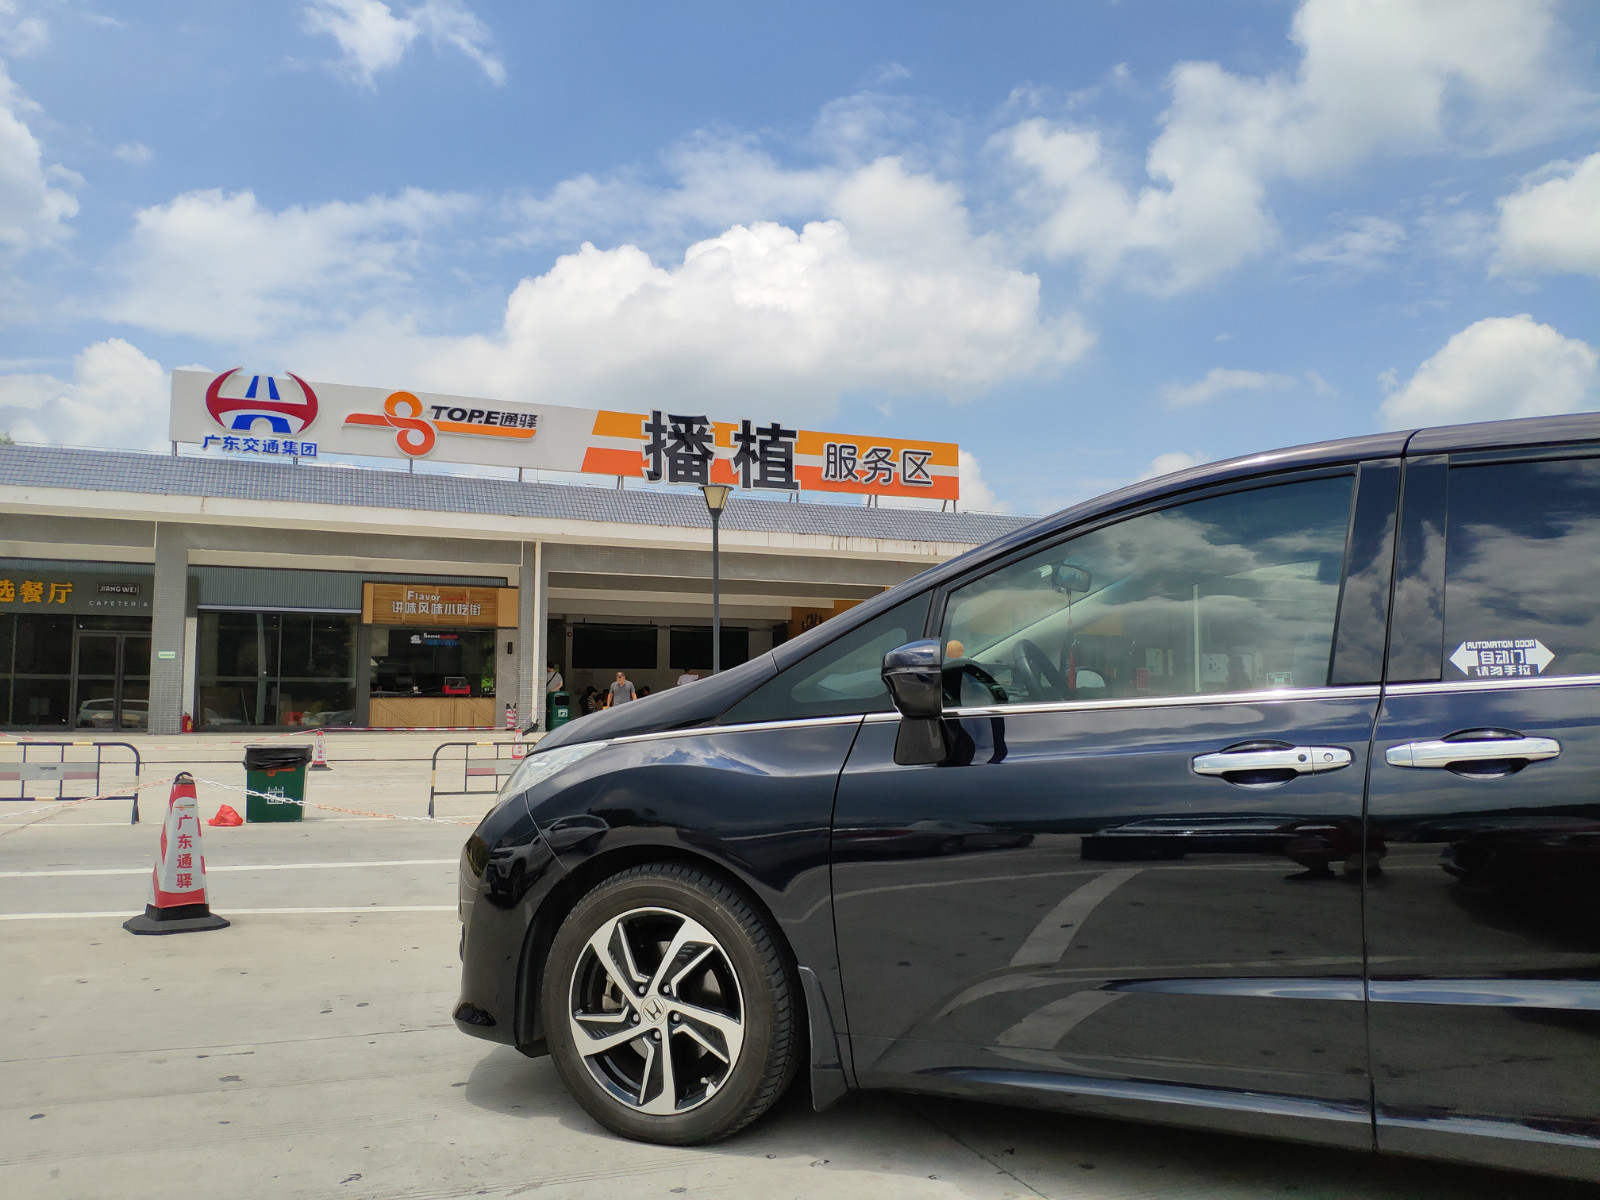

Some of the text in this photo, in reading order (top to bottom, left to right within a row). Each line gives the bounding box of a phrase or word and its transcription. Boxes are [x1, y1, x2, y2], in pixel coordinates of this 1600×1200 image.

[202, 434, 318, 458] 广东交通集团
[643, 408, 933, 491] 播植 服务区
[407, 591, 441, 602] Flavor
[392, 600, 482, 616] 讲味风味小吃街
[1466, 639, 1535, 650] AUTOMATION DOOR
[1480, 649, 1525, 665] 自动门
[1475, 664, 1531, 677] 请勿手拉
[176, 814, 193, 889] 广东通驿
